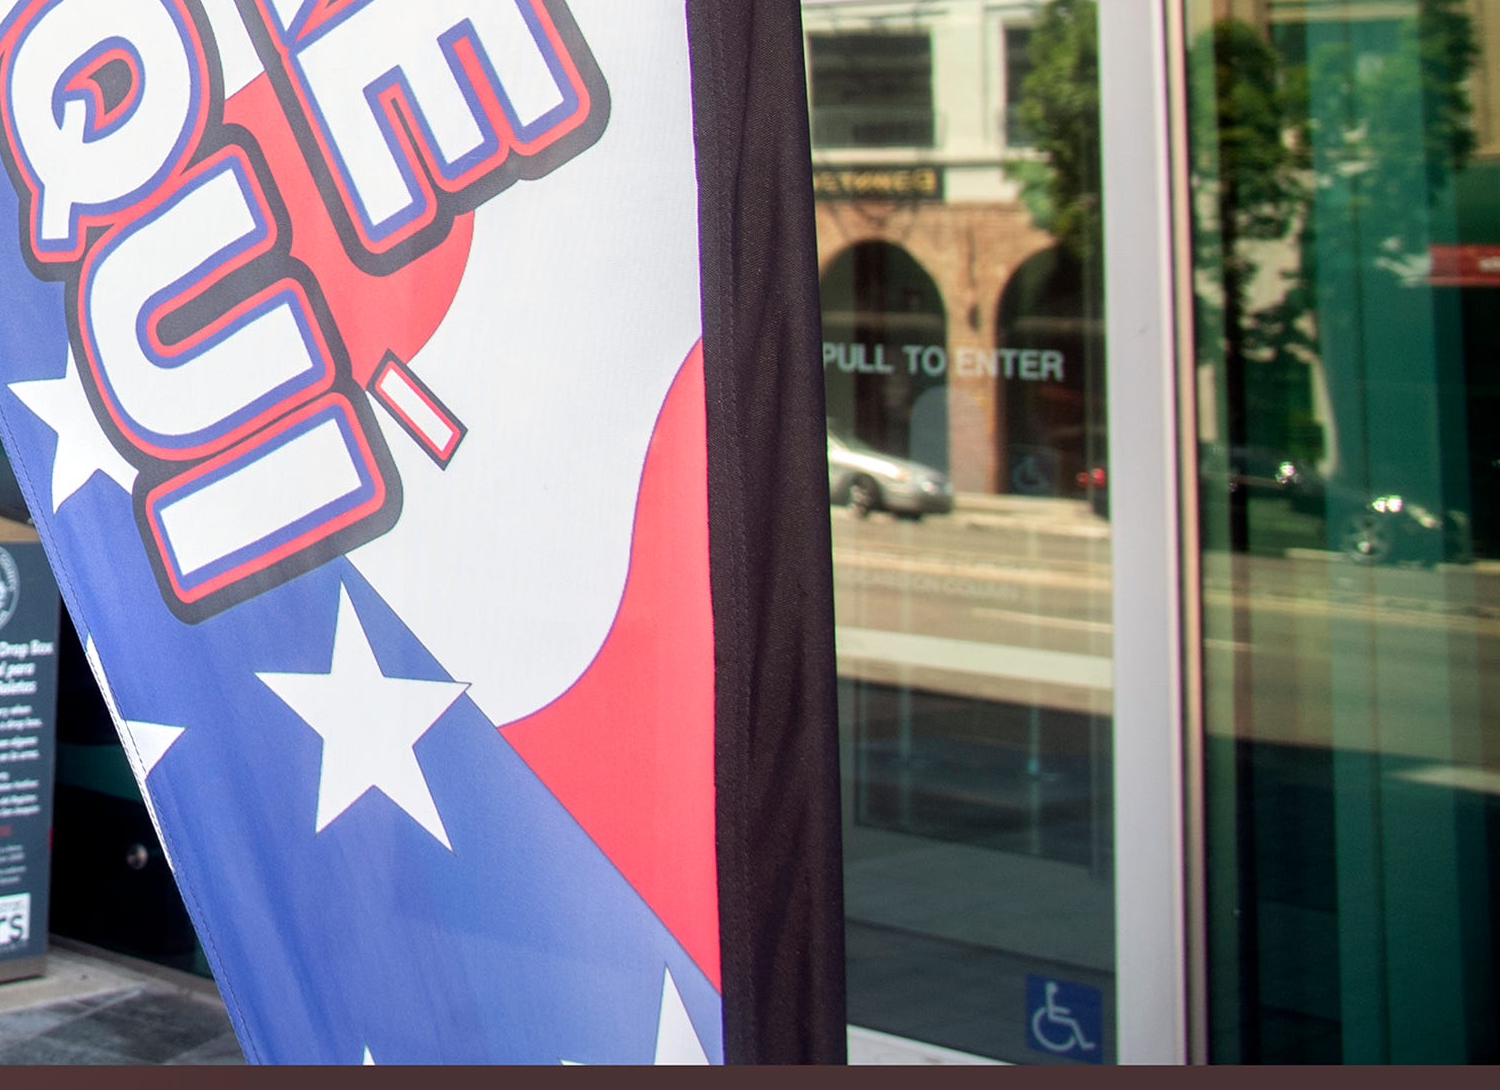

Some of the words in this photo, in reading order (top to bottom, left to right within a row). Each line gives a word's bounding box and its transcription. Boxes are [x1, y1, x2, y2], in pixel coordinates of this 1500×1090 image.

[822, 342, 894, 373] PULL
[903, 344, 946, 375] TO
[955, 347, 1065, 381] ENTER
[30, 639, 54, 656] Box
[5, 663, 36, 680] para
